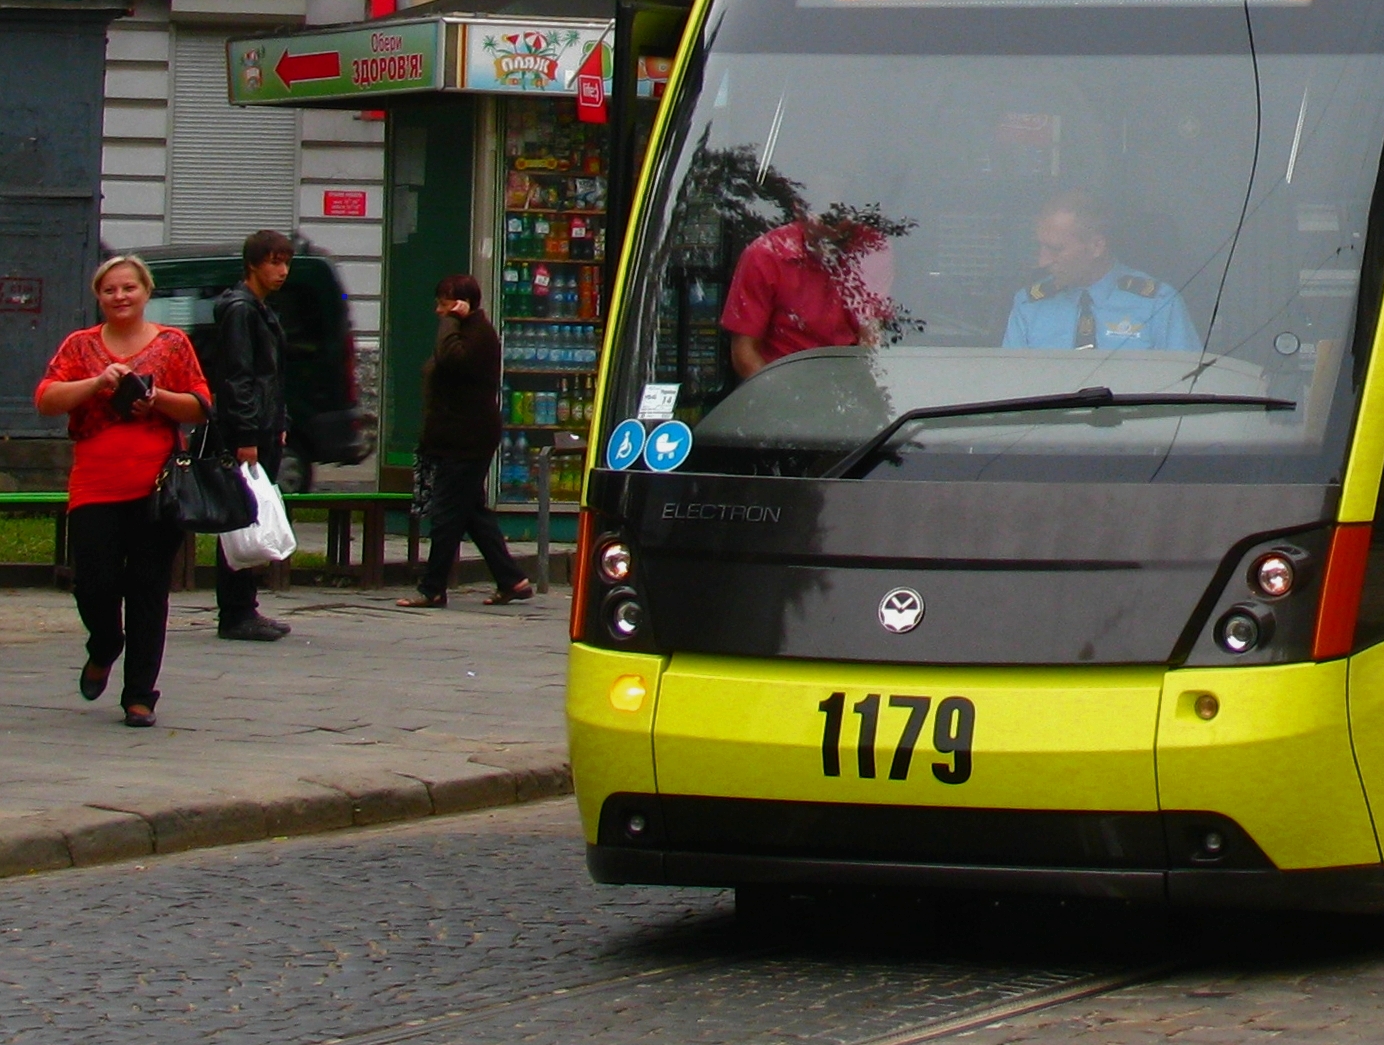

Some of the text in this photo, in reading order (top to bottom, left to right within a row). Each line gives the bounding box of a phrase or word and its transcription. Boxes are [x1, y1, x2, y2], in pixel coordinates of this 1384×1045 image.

[371, 33, 402, 54] Обери
[353, 54, 424, 88] ЗДОРОВ'Я!
[661, 502, 782, 523] ELECTRON
[818, 692, 976, 785] 1179
